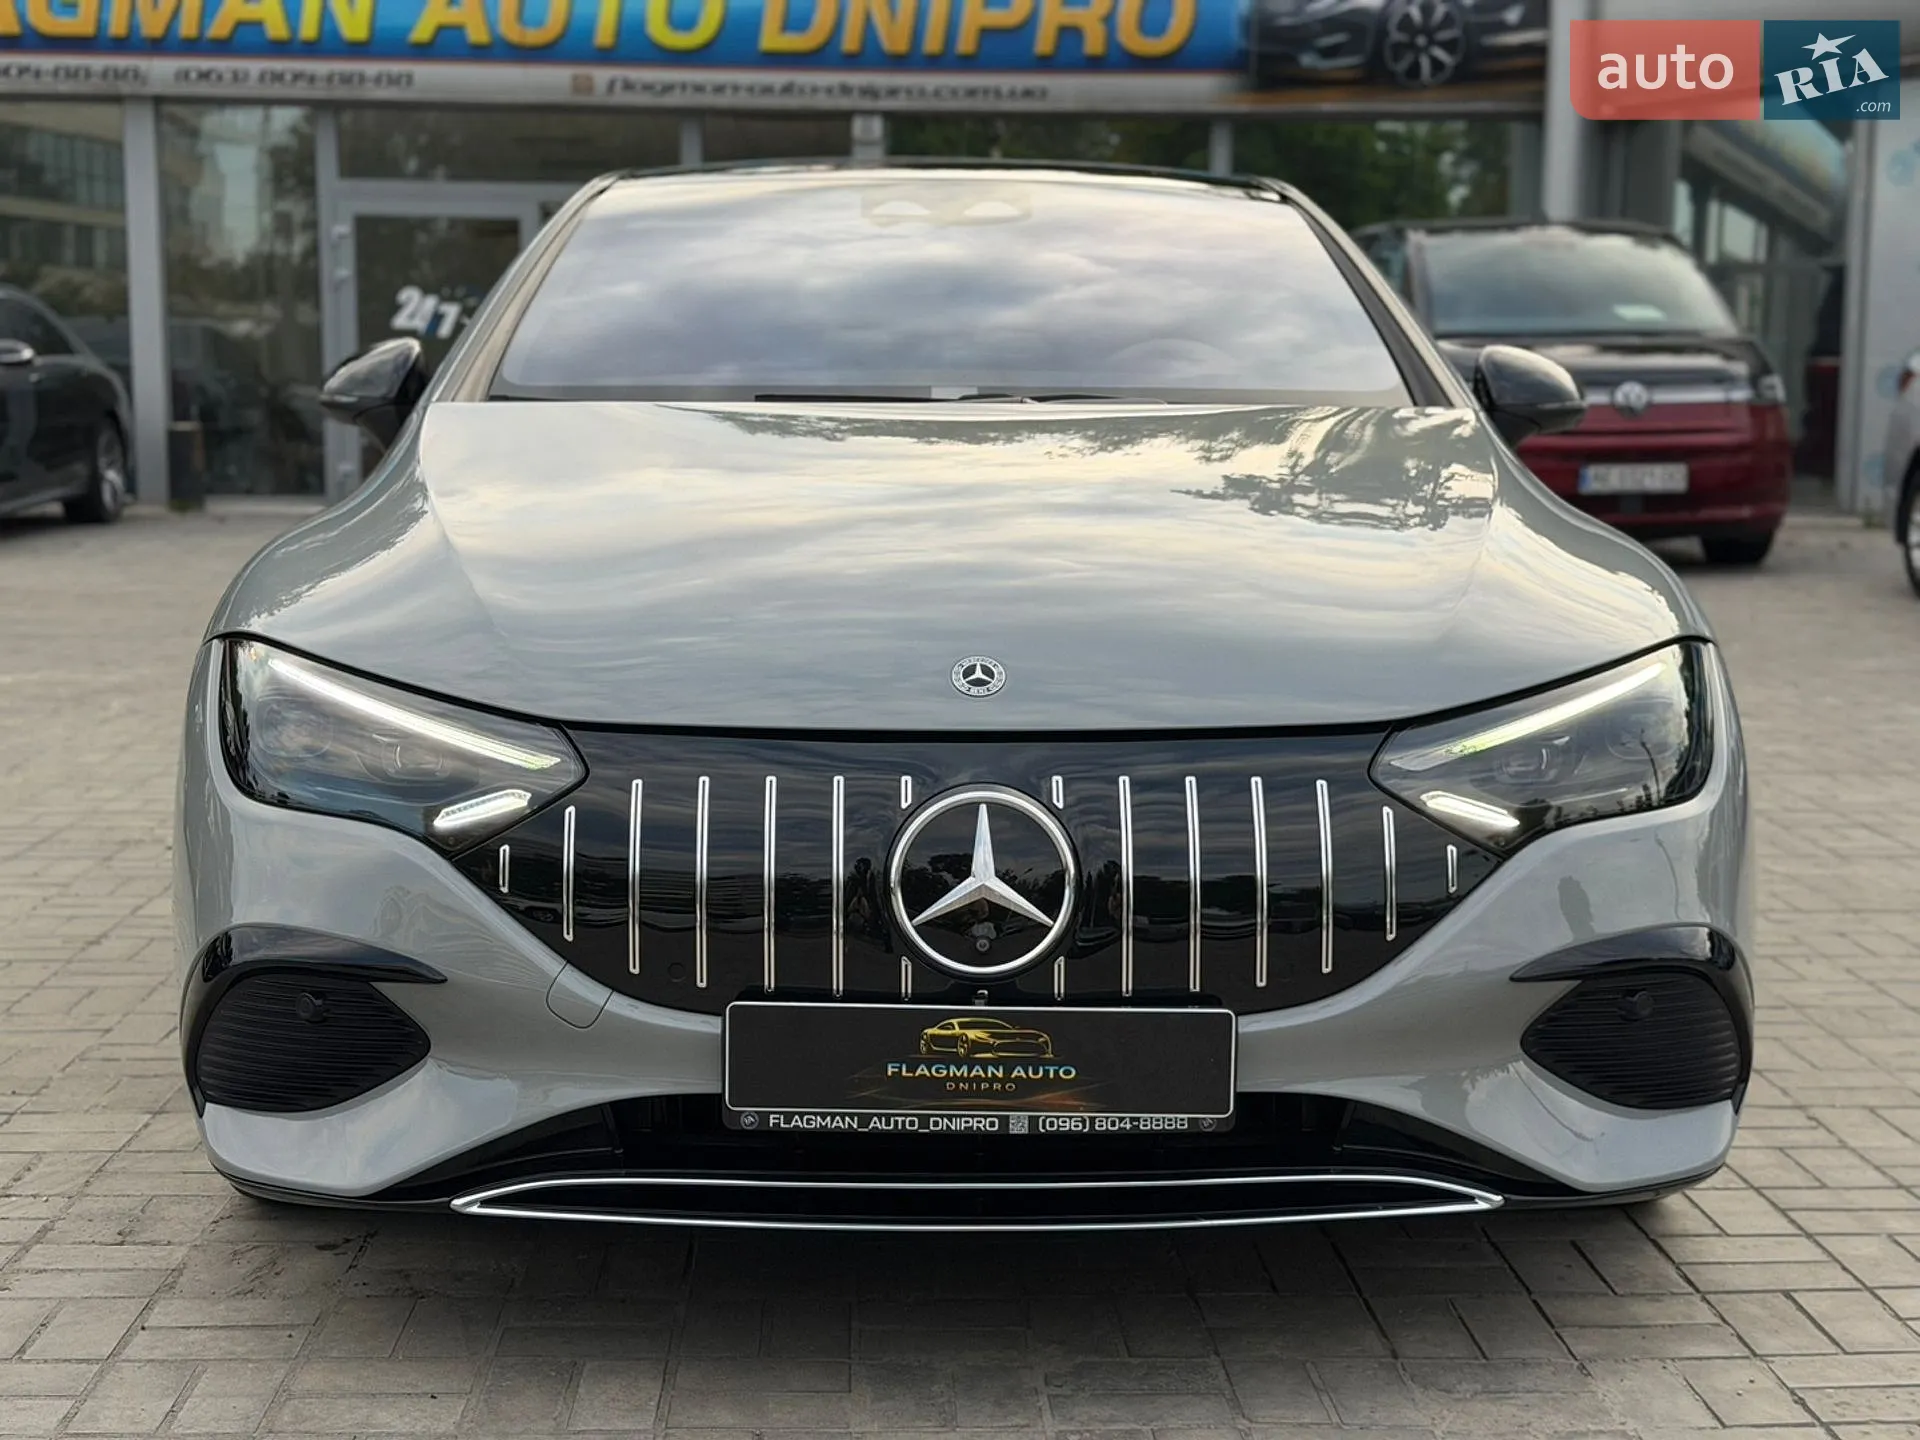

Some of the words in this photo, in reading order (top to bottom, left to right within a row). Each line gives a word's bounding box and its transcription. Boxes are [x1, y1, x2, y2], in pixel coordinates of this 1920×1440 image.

[0, 0, 374, 42] GMAN
[407, 0, 724, 50] AUTO
[758, 0, 1196, 57] DNIPRO
[886, 1063, 1003, 1078] FLAGMAN
[1010, 1065, 1076, 1079] AUTO
[946, 1081, 1016, 1092] DNIPRO
[1038, 1116, 1090, 1133] (096)
[1094, 1117, 1188, 1130] 804-8888
